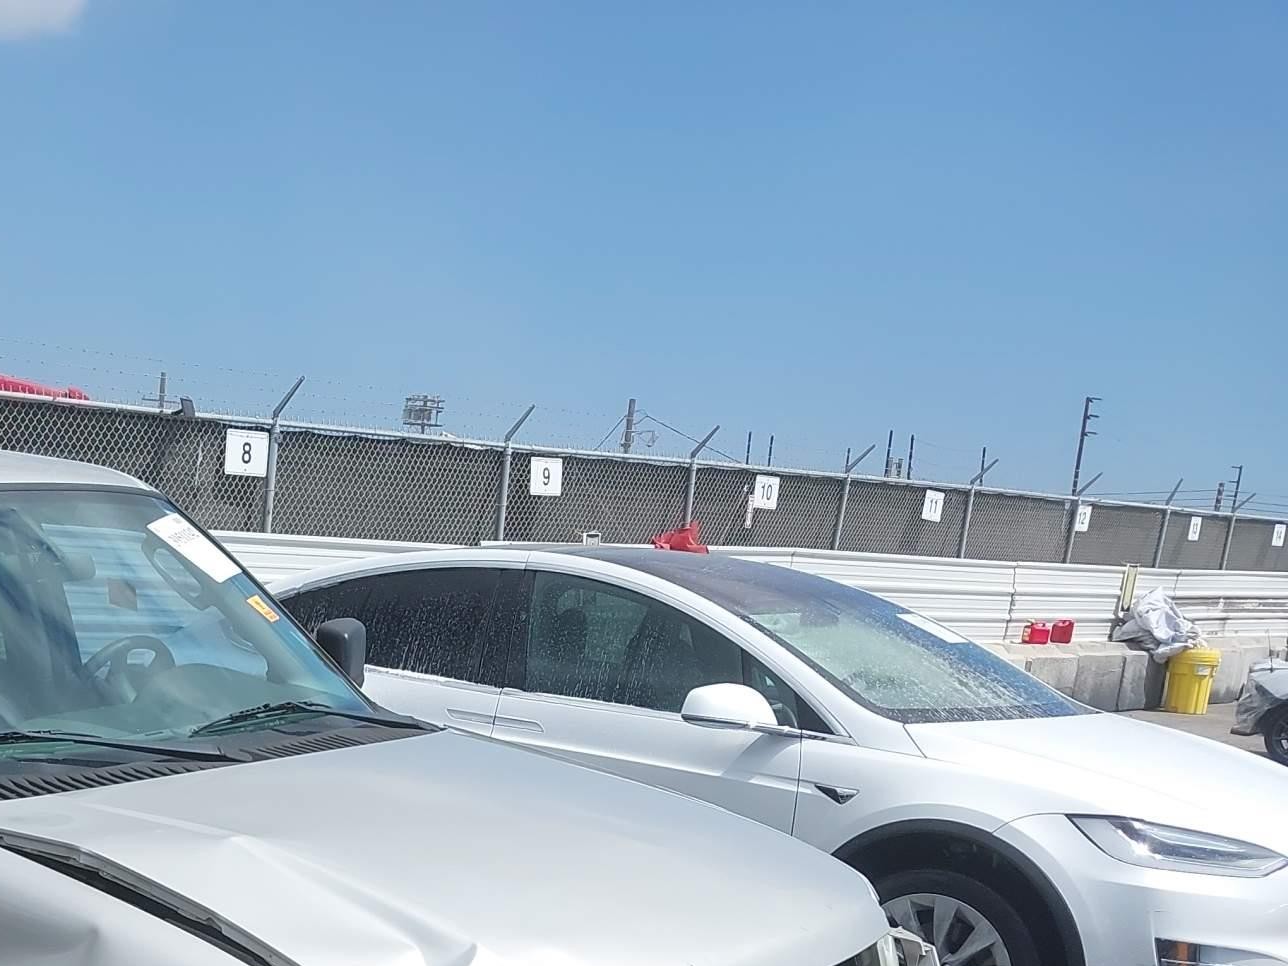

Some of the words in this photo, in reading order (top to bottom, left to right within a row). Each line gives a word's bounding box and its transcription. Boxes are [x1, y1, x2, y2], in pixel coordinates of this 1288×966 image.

[241, 442, 252, 465] 8
[541, 466, 551, 486] 9
[761, 482, 773, 501] 10
[929, 499, 938, 514] 11
[1078, 511, 1087, 525] 12
